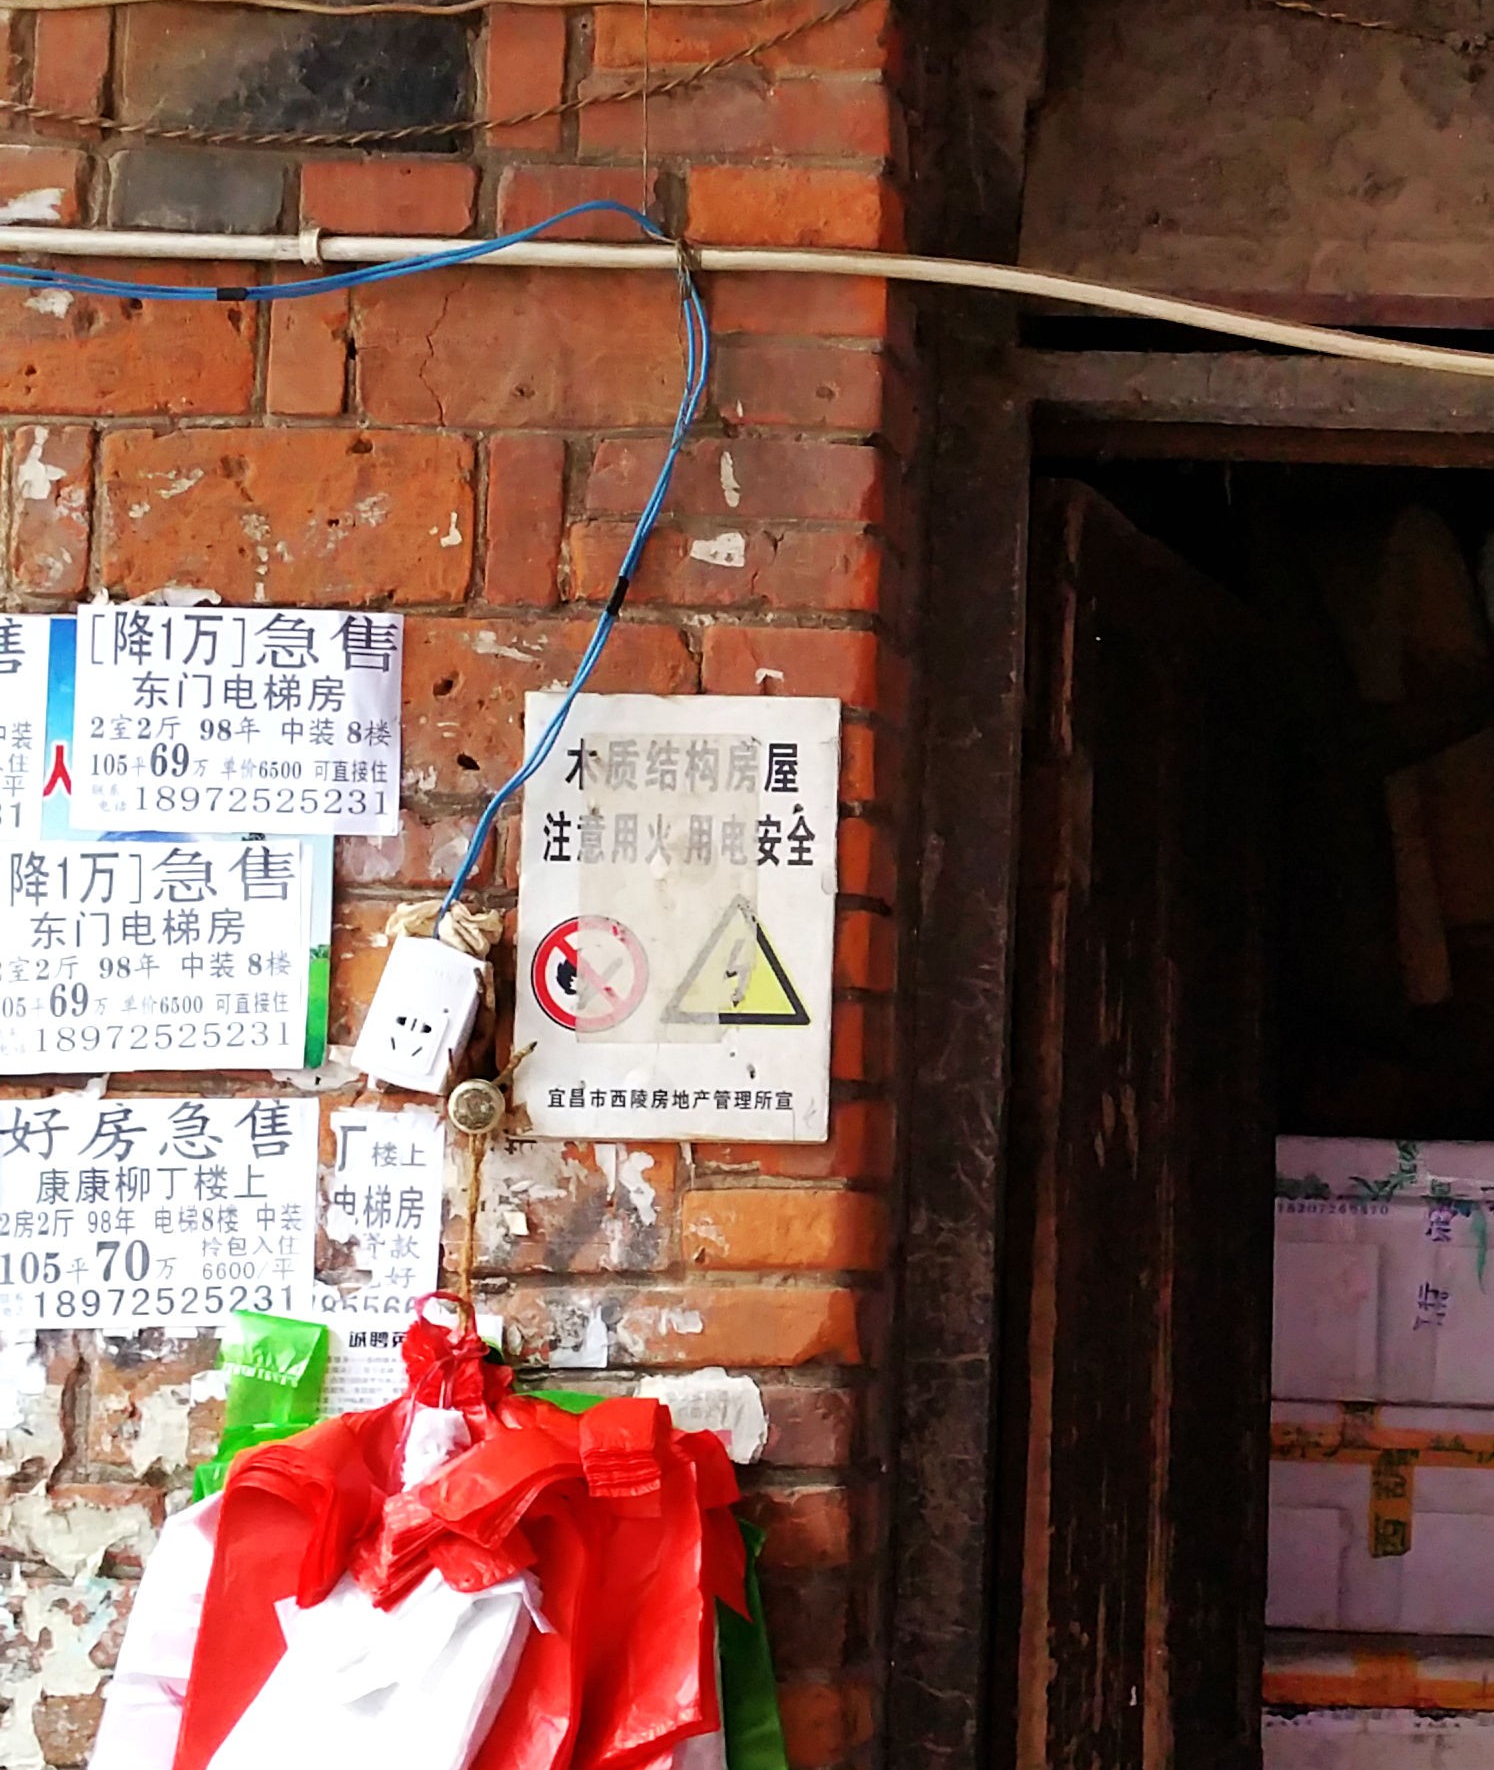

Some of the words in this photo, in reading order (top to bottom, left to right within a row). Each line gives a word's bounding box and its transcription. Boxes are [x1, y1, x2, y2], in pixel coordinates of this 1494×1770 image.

[91, 610, 399, 674] [降1万]急售
[133, 672, 346, 713] 东门电梯房
[91, 713, 182, 741] 2室2厅
[200, 716, 261, 742] 98年
[281, 718, 335, 747] 中装
[347, 719, 393, 748] 8楼
[314, 759, 389, 785] 可直接住
[564, 738, 799, 794] 木质结构房屋
[136, 786, 389, 817] 18972525231
[543, 809, 816, 867] 注意用火用电安全
[30, 907, 247, 948] 东门电梯房
[0, 955, 79, 982] 室2厅
[99, 953, 161, 980] 98年
[181, 953, 236, 978] 中装
[248, 951, 293, 977] 8楼
[216, 991, 290, 1015] 可直接住
[36, 1022, 290, 1053] 18972525231
[547, 1087, 794, 1112] 宜昌市西陵房地产管理所宣
[0, 1099, 293, 1162] 好房急售
[36, 1165, 268, 1205] 康康柳丁楼上
[0, 1208, 75, 1238] 2房2厅
[87, 1207, 136, 1236] 98年
[155, 1203, 240, 1234] 电梯8楼
[257, 1203, 302, 1232] 中装
[202, 1235, 300, 1258] 拎包入住
[202, 1257, 295, 1282] 6600/平
[35, 1285, 293, 1319] 18972525231
